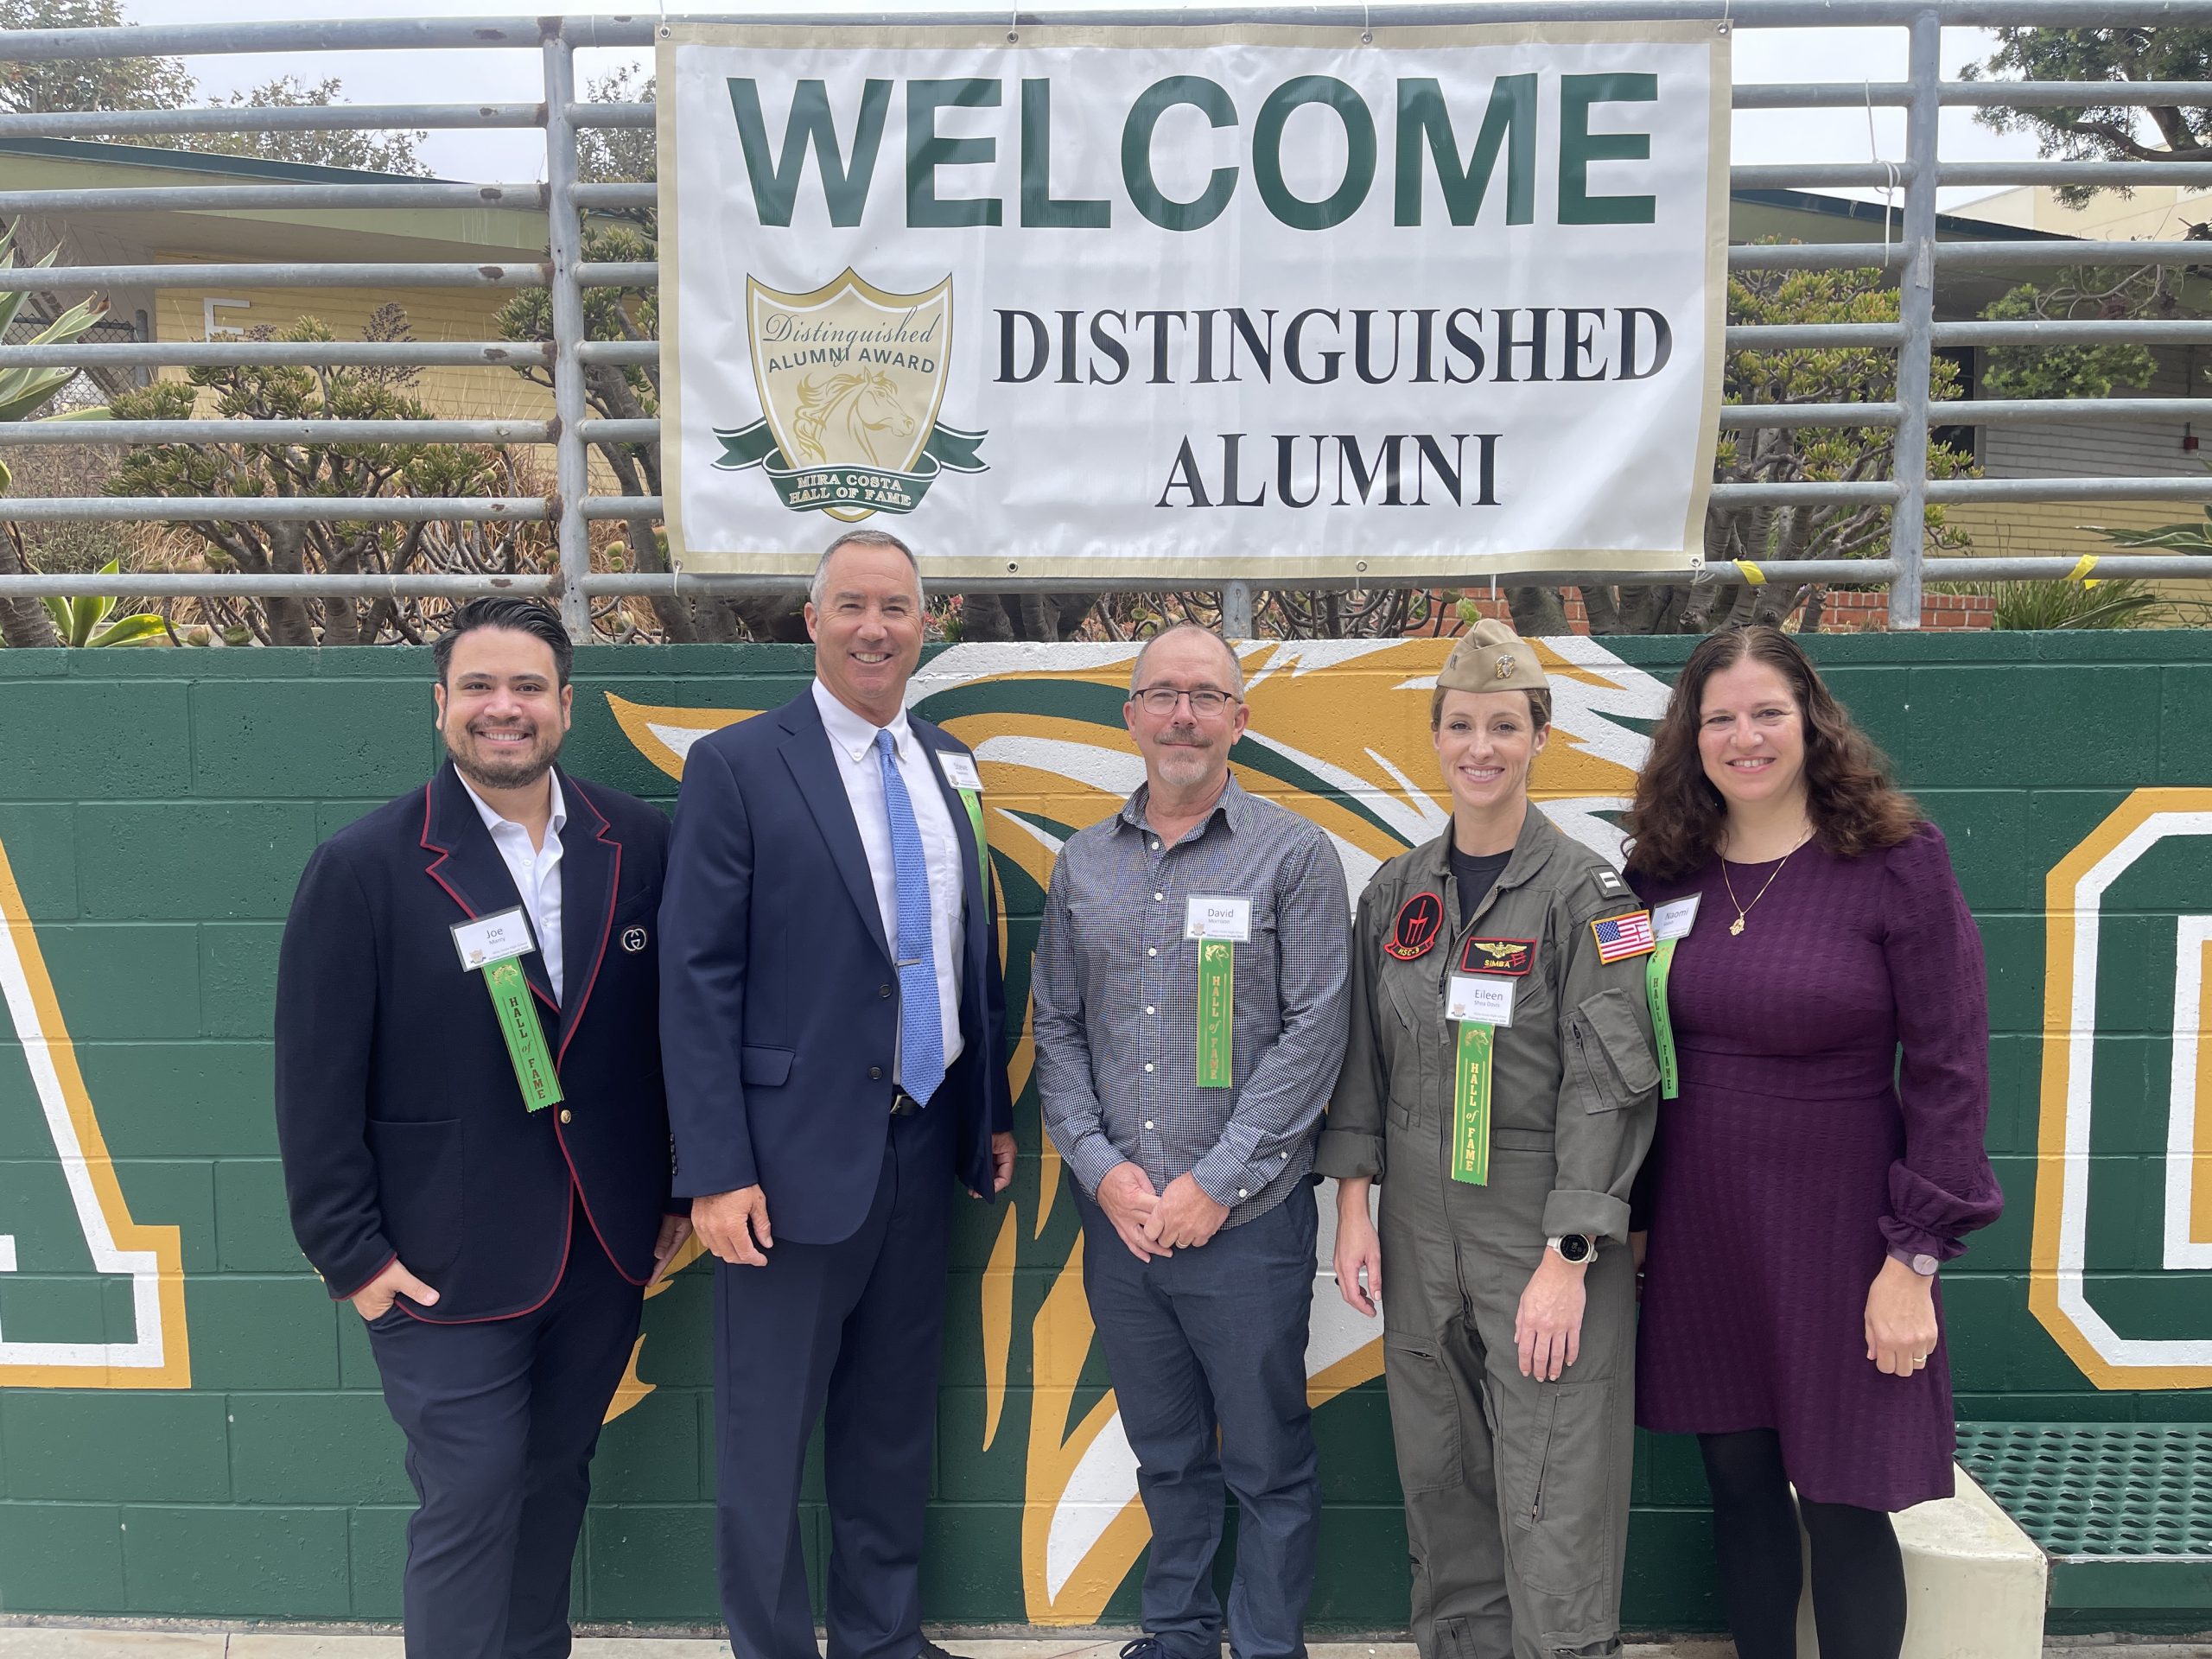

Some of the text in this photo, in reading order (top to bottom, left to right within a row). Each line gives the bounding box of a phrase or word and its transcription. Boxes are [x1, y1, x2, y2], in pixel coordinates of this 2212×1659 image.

[727, 73, 1658, 232] WELCOME
[762, 305, 942, 368] Distinguished
[993, 306, 1672, 386] DISTINGUISHED
[768, 346, 935, 374] ALUMNI AWARD
[797, 474, 903, 492] MIRA COSTA
[1154, 432, 1503, 508] ALUMNI
[789, 486, 912, 506] HALL OF FAME
[1208, 908, 1234, 918] David
[1665, 907, 1689, 920] Naomi
[486, 928, 503, 939] Joe
[1398, 947, 1420, 957] HSC-9
[1484, 959, 1510, 969] SIMBA
[1474, 989, 1503, 1001] Eileen
[1209, 976, 1222, 1080] HALL of FAME
[1652, 977, 1662, 1022] HALL
[1662, 1044, 1671, 1090] FAME
[509, 996, 546, 1099] HALL of FAME
[1465, 1062, 1480, 1172] HALL of FAME
